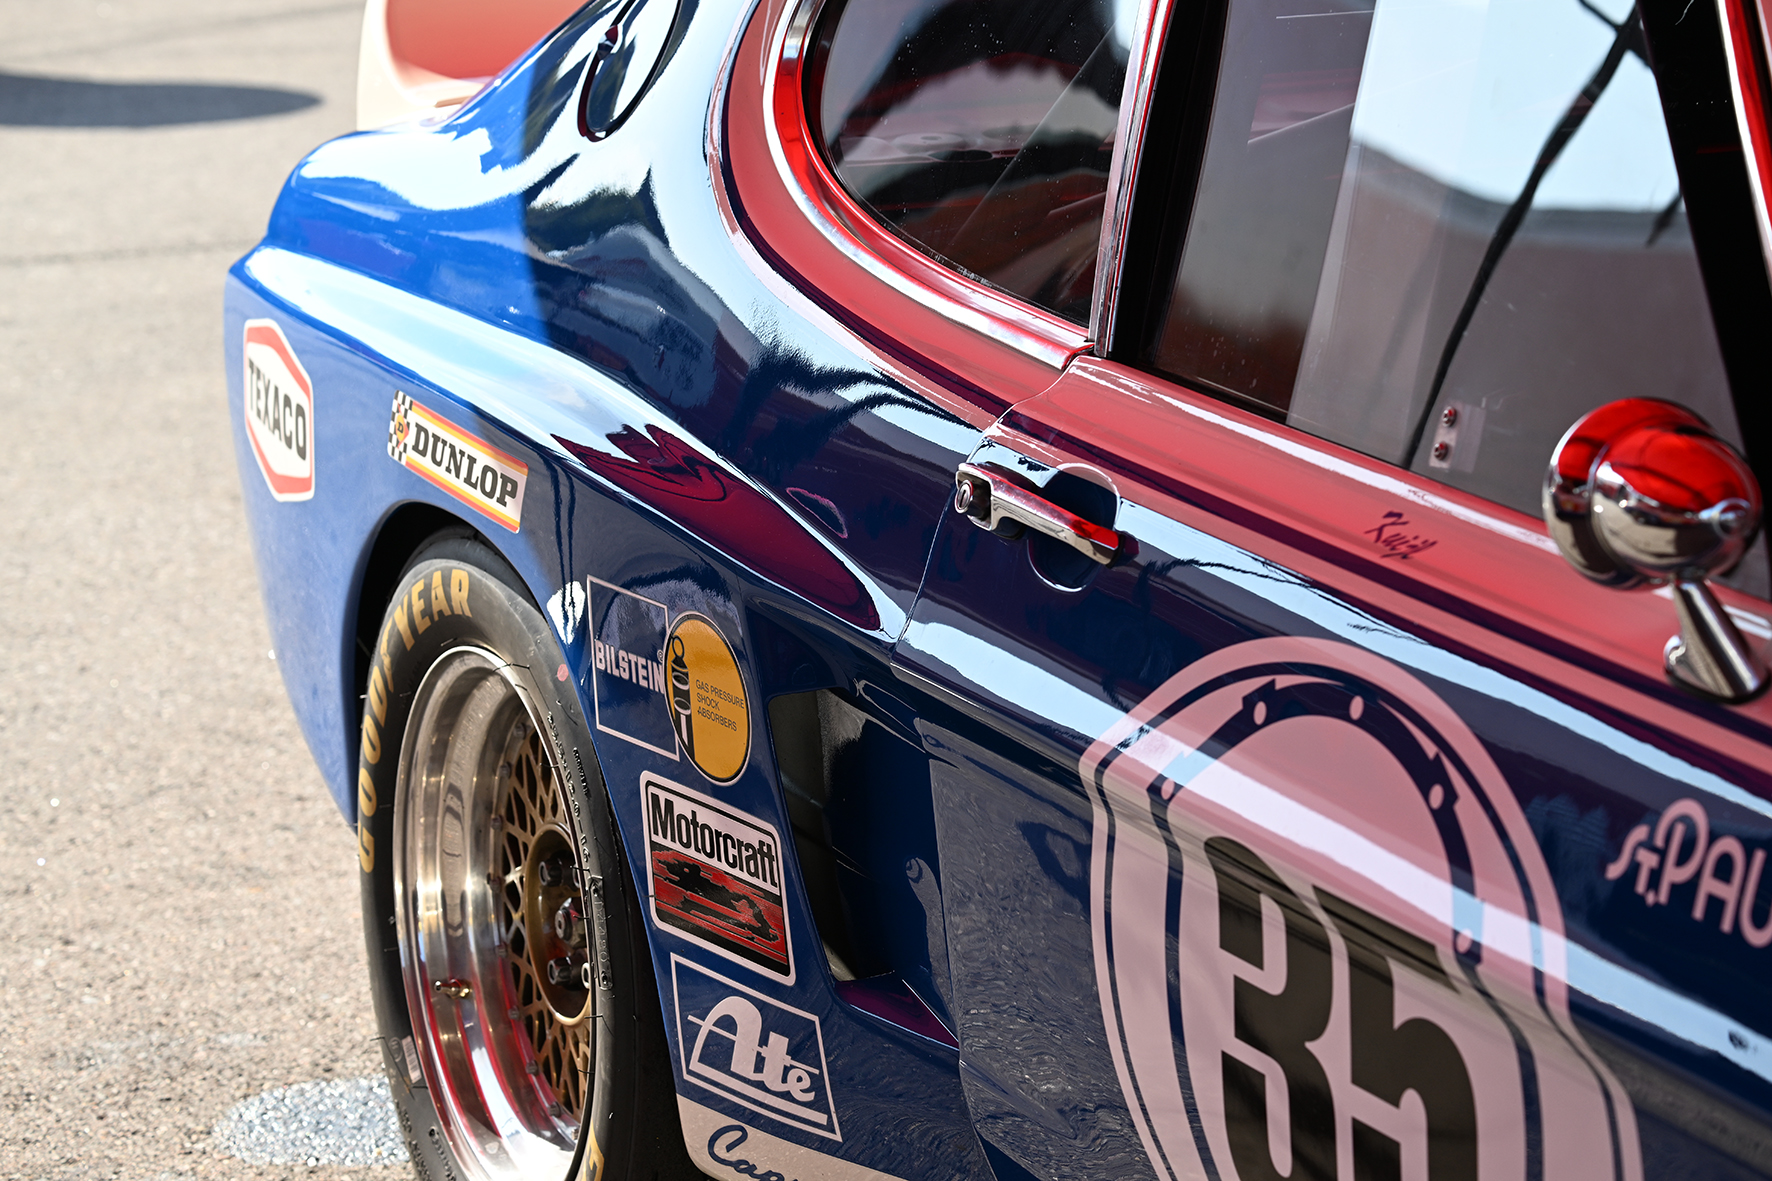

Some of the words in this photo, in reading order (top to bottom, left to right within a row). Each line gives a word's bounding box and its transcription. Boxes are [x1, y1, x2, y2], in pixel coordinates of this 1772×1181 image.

[248, 357, 308, 461] TEXACO
[412, 421, 518, 508] DUNLOP
[594, 638, 664, 694] BILSTEIN
[696, 679, 709, 693] GAS
[711, 685, 744, 709] PRESSURE
[697, 692, 720, 711] SHOCK
[358, 569, 473, 874] GOODYEAR
[697, 706, 738, 732] ABSORBERS
[651, 792, 778, 888] Motorcraft
[687, 996, 827, 1106] Ate
[1204, 836, 1479, 1181] 35
